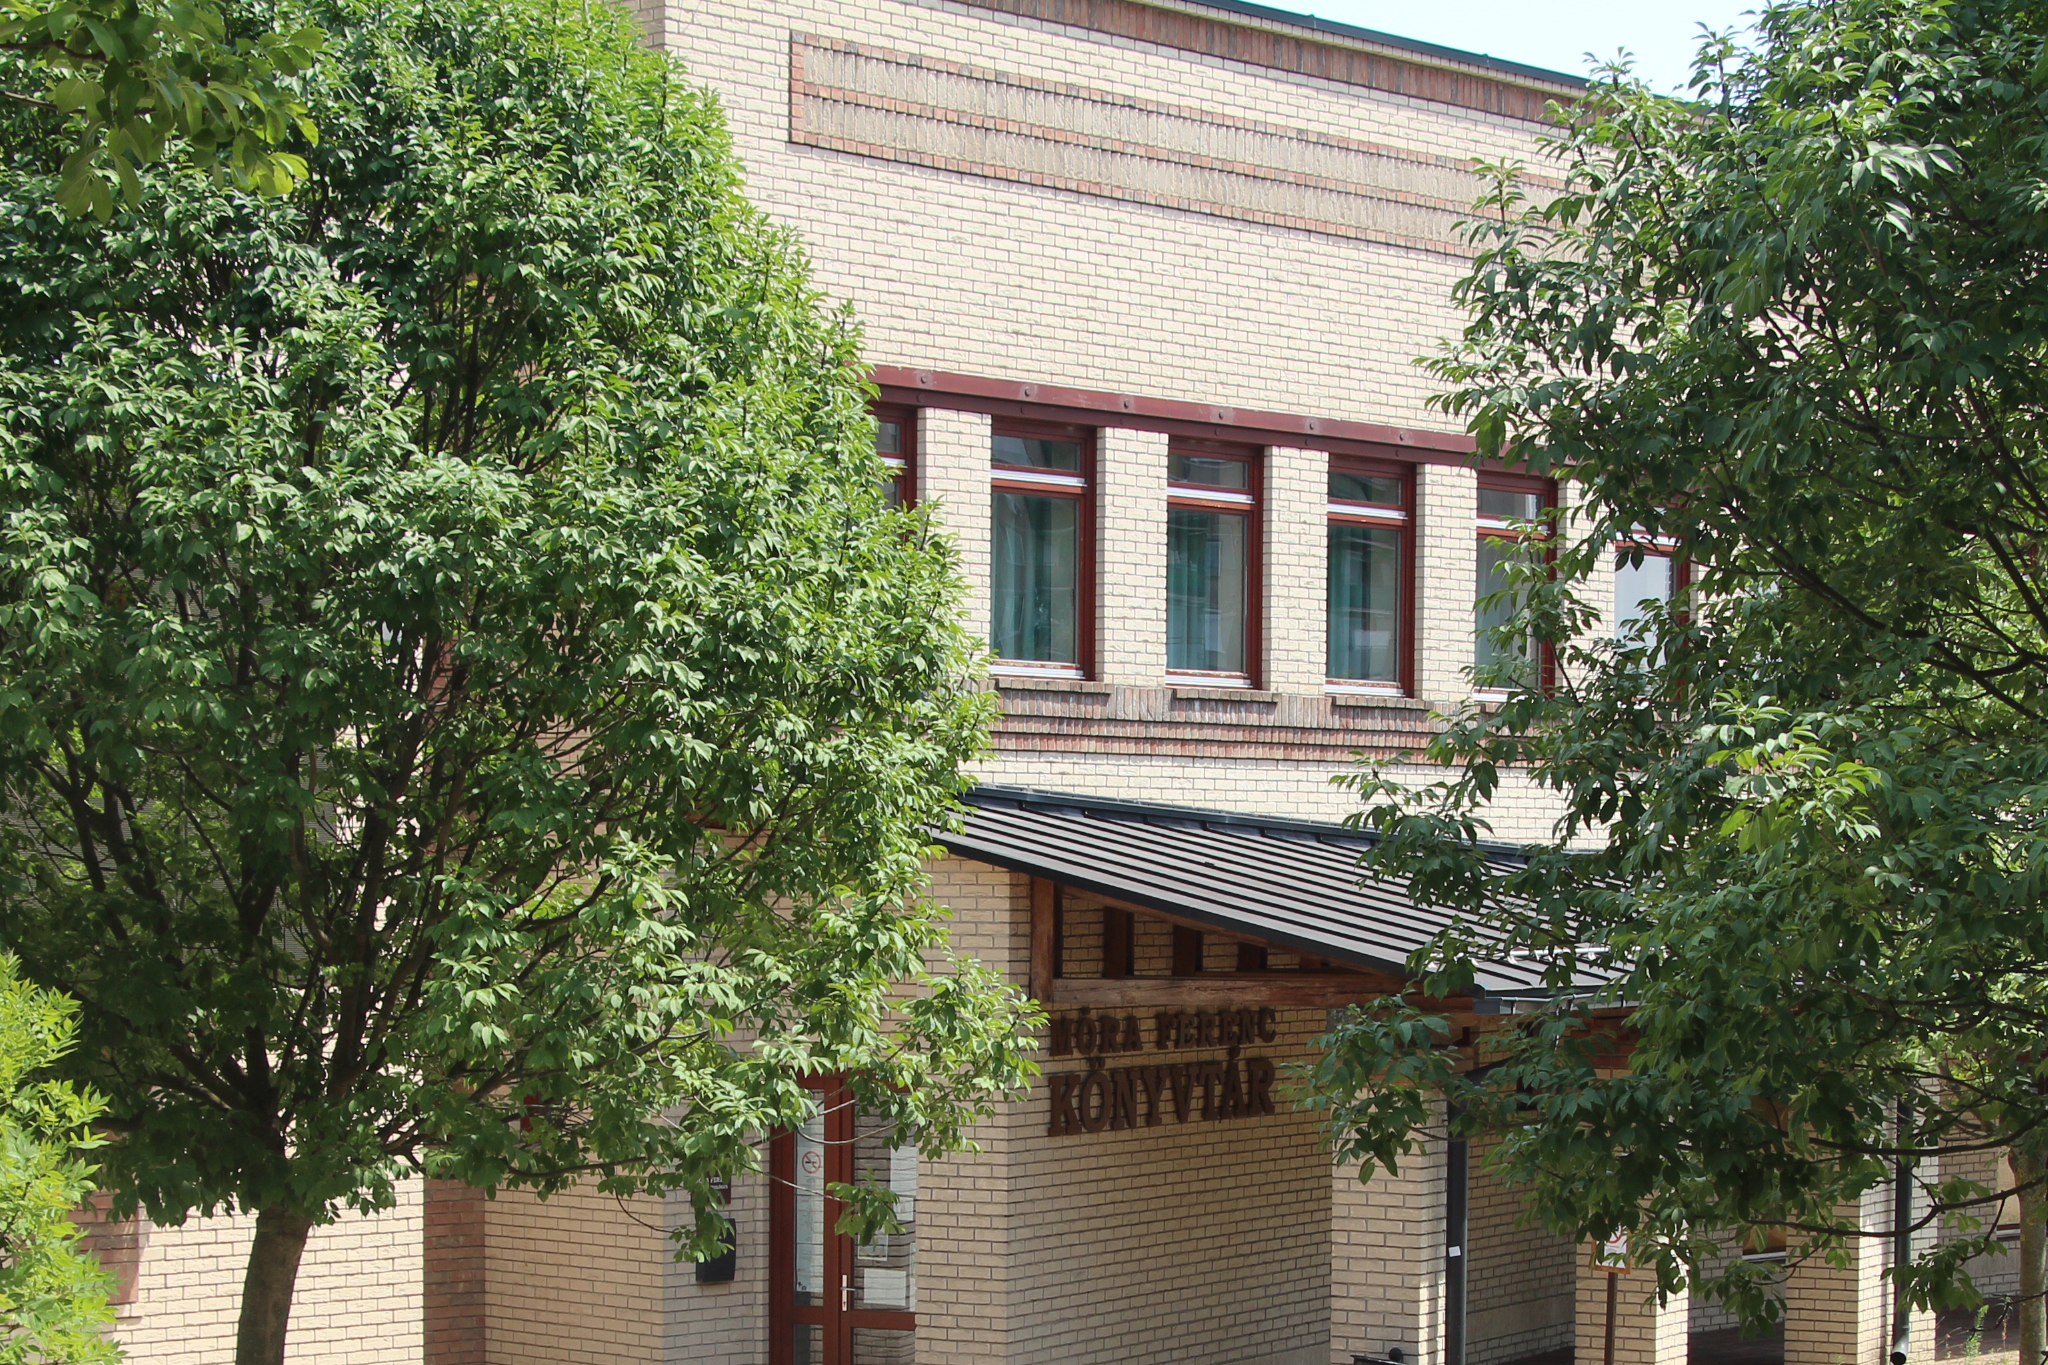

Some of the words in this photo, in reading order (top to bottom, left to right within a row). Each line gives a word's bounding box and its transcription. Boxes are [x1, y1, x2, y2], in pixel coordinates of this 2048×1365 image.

[1049, 1006, 1143, 1056] MÓRA
[1156, 1007, 1277, 1050] FERENC
[1048, 1045, 1276, 1137] KÖNYVTÁR
